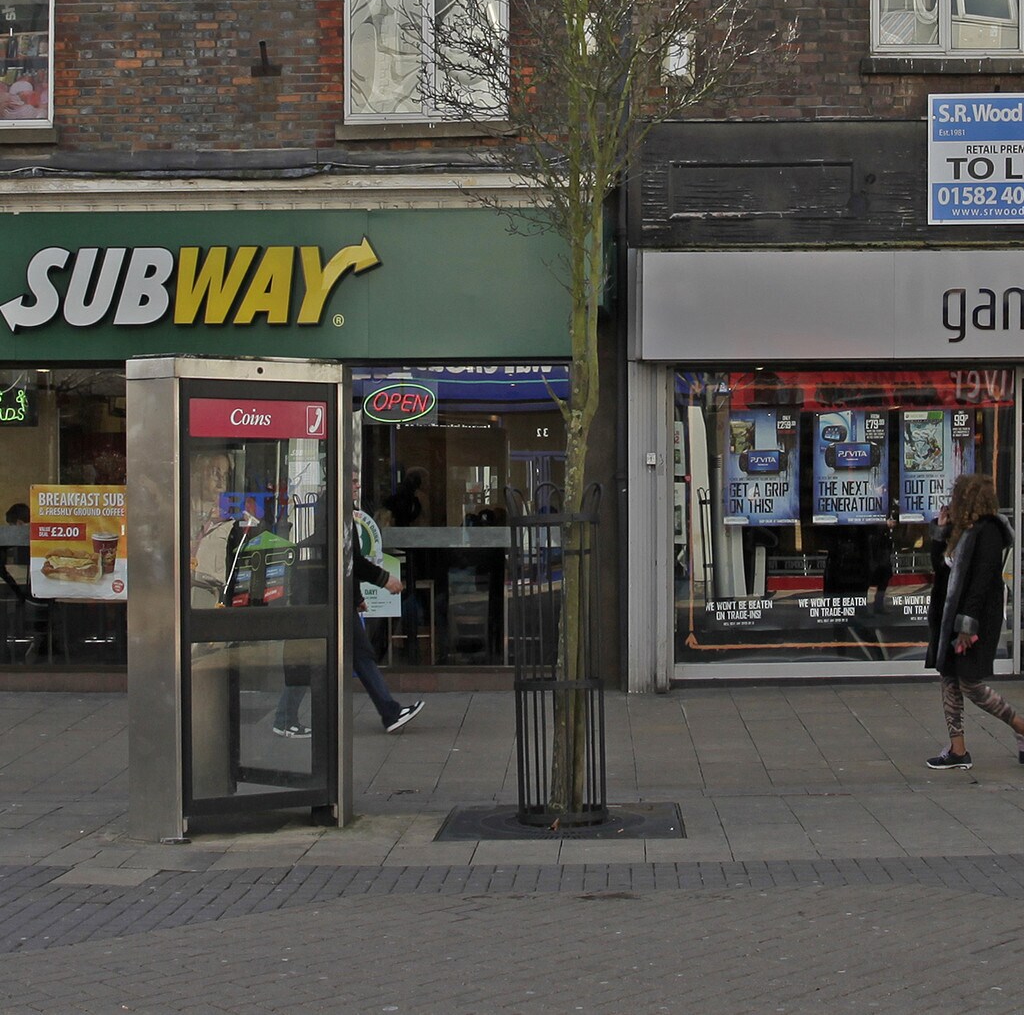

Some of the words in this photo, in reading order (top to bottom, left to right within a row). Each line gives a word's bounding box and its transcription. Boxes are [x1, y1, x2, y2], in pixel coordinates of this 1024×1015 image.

[938, 103, 971, 123] S.R.
[972, 102, 1023, 122] Wood
[966, 144, 999, 155] RETAIL
[946, 157, 995, 180] TO
[937, 186, 998, 206] 01582
[0, 235, 381, 333] SUBWAY
[372, 391, 429, 413] OPEN
[229, 408, 272, 427] Coins
[729, 482, 749, 498] GET
[752, 482, 761, 497] A
[764, 481, 790, 498] GRIP
[818, 480, 839, 496] THE
[841, 481, 870, 496] NEXT
[904, 479, 925, 495] OUT
[929, 479, 944, 494] ON
[38, 492, 100, 507] BREAKFAST
[729, 498, 744, 514] ON
[747, 498, 774, 514] THIS!
[818, 497, 883, 513] GENERATION
[904, 495, 924, 511] THE
[38, 507, 45, 516] &
[45, 507, 73, 516] FRESHLY
[73, 507, 101, 516] GROUND
[101, 507, 125, 517] COFFEE
[50, 526, 80, 538] £2.00
[738, 600, 747, 610] BE
[748, 599, 773, 610] BEATEN
[832, 597, 841, 607] BE
[842, 596, 867, 607] BEATEN
[716, 610, 726, 621] ON
[810, 607, 820, 618] ON
[903, 605, 913, 615] ON
